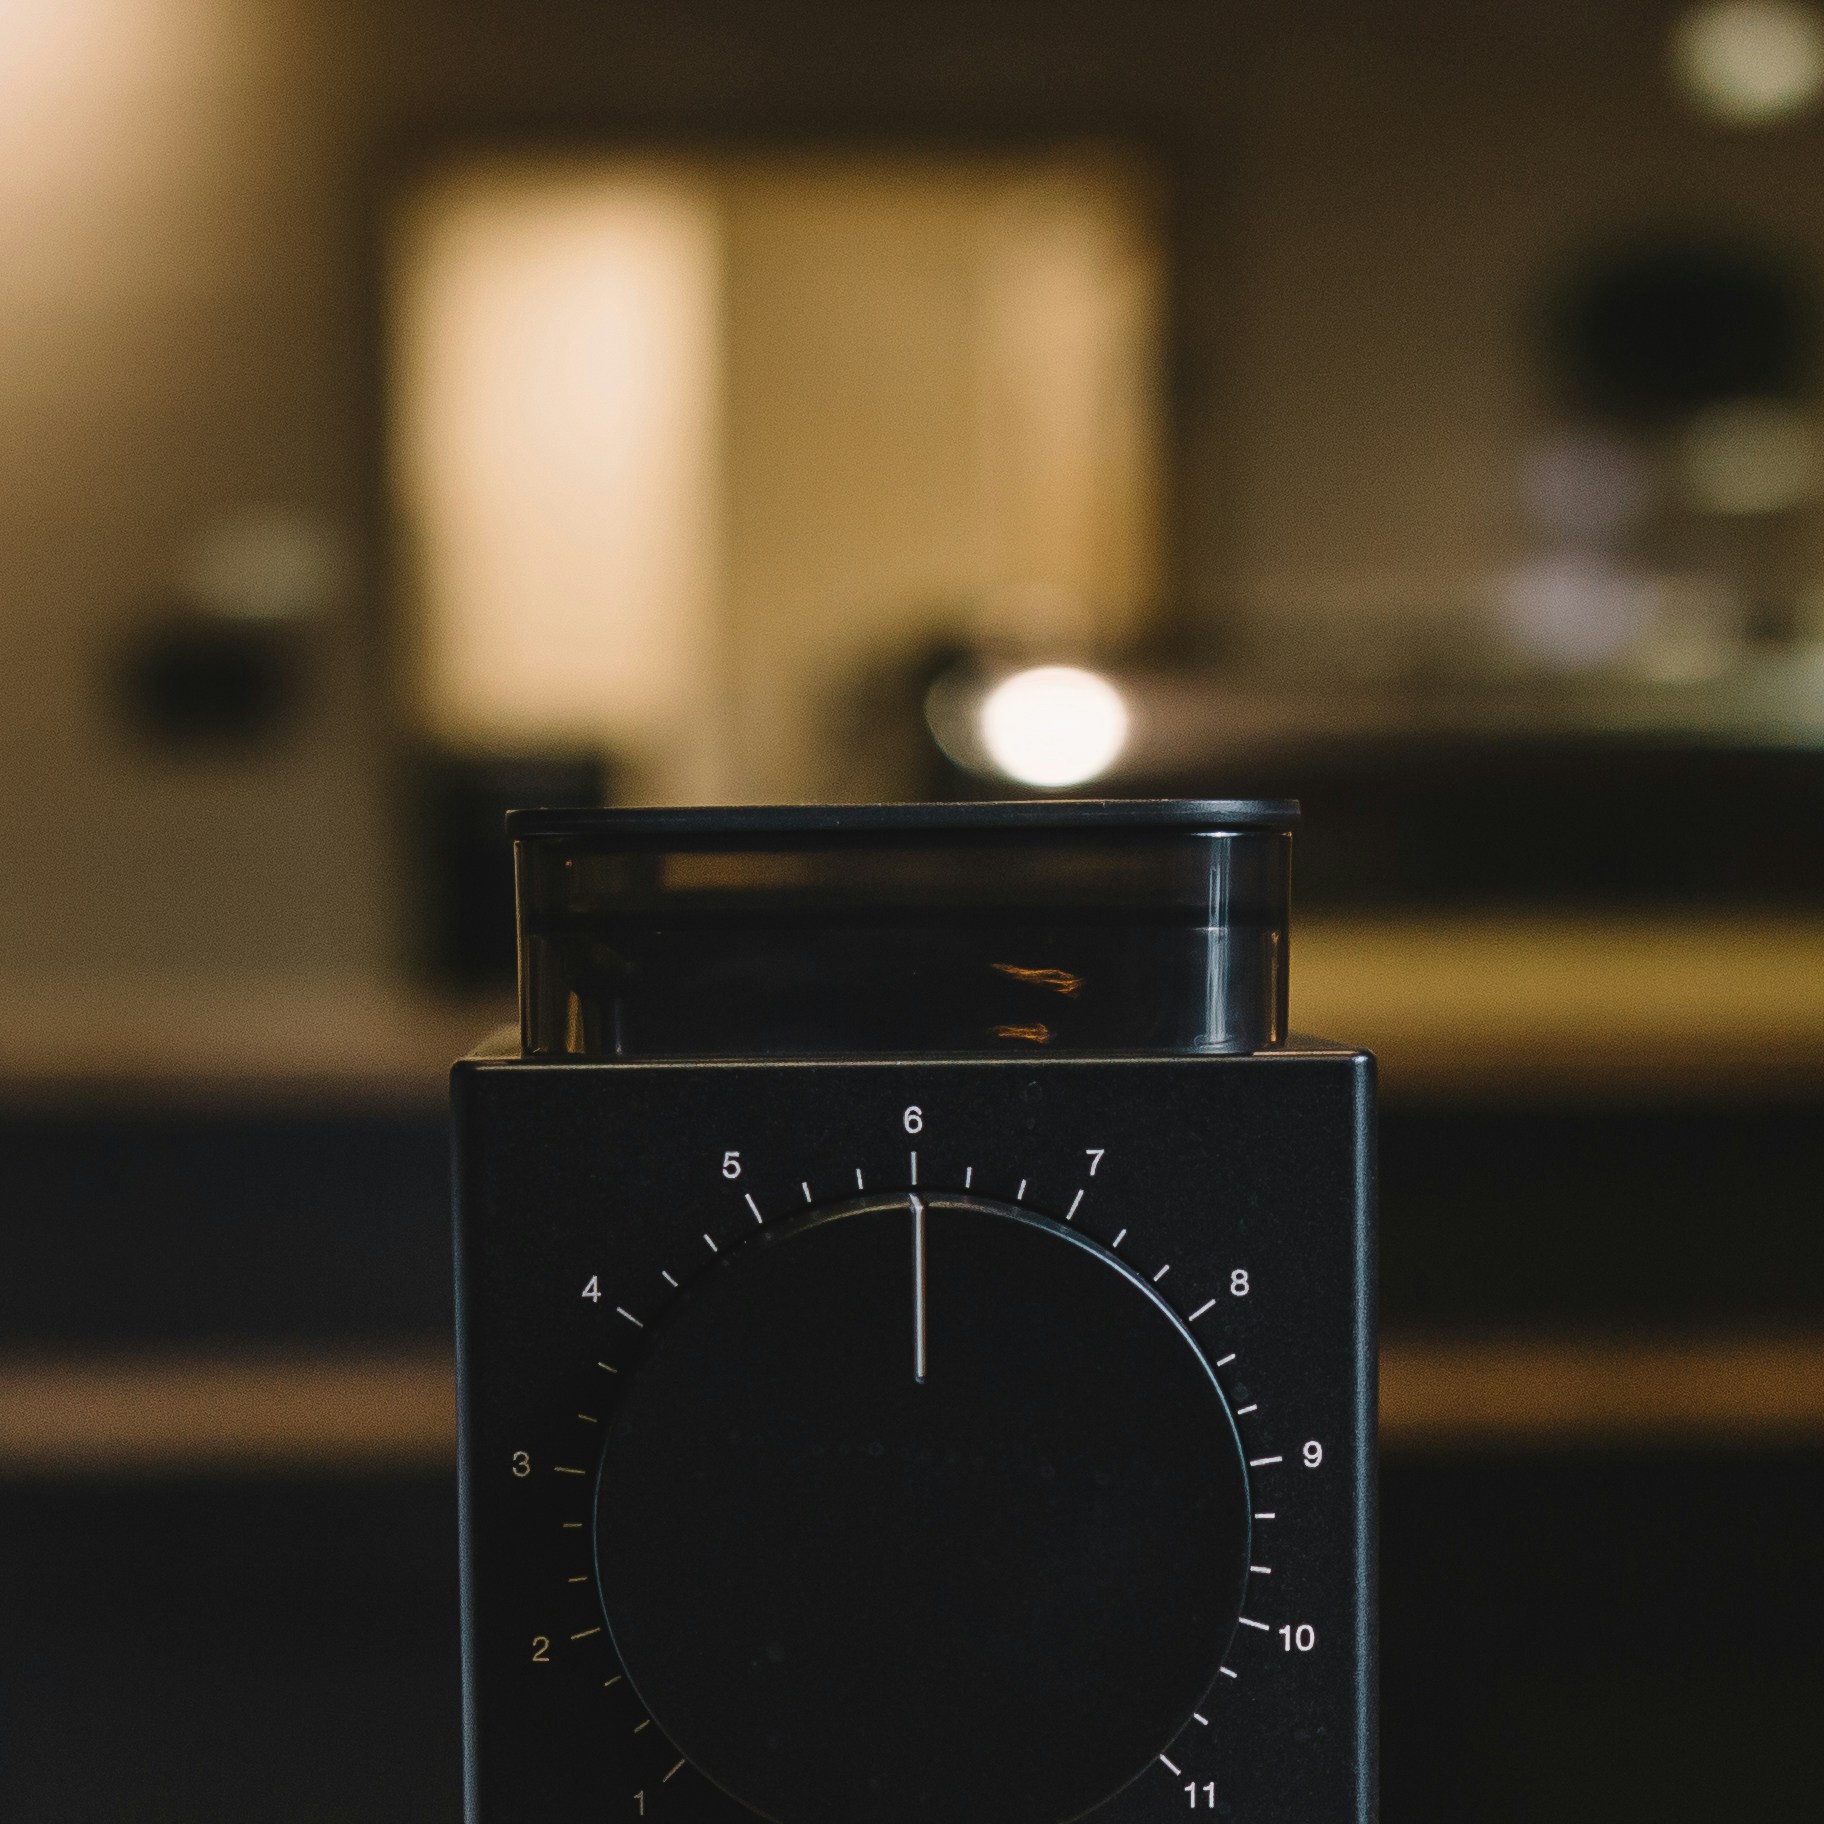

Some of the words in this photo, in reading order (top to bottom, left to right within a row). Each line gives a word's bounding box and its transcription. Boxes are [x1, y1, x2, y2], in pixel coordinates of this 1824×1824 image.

[903, 1106, 923, 1133] 6
[722, 1151, 741, 1179] 5
[1086, 1149, 1104, 1176] 7
[582, 1276, 601, 1302] 4
[1230, 1269, 1249, 1296] 8
[513, 1451, 530, 1477] 3
[1303, 1440, 1322, 1468] 9
[533, 1636, 549, 1661] 2
[1279, 1624, 1315, 1651] 10
[634, 1791, 643, 1815] 1
[1184, 1782, 1214, 1808] 11
